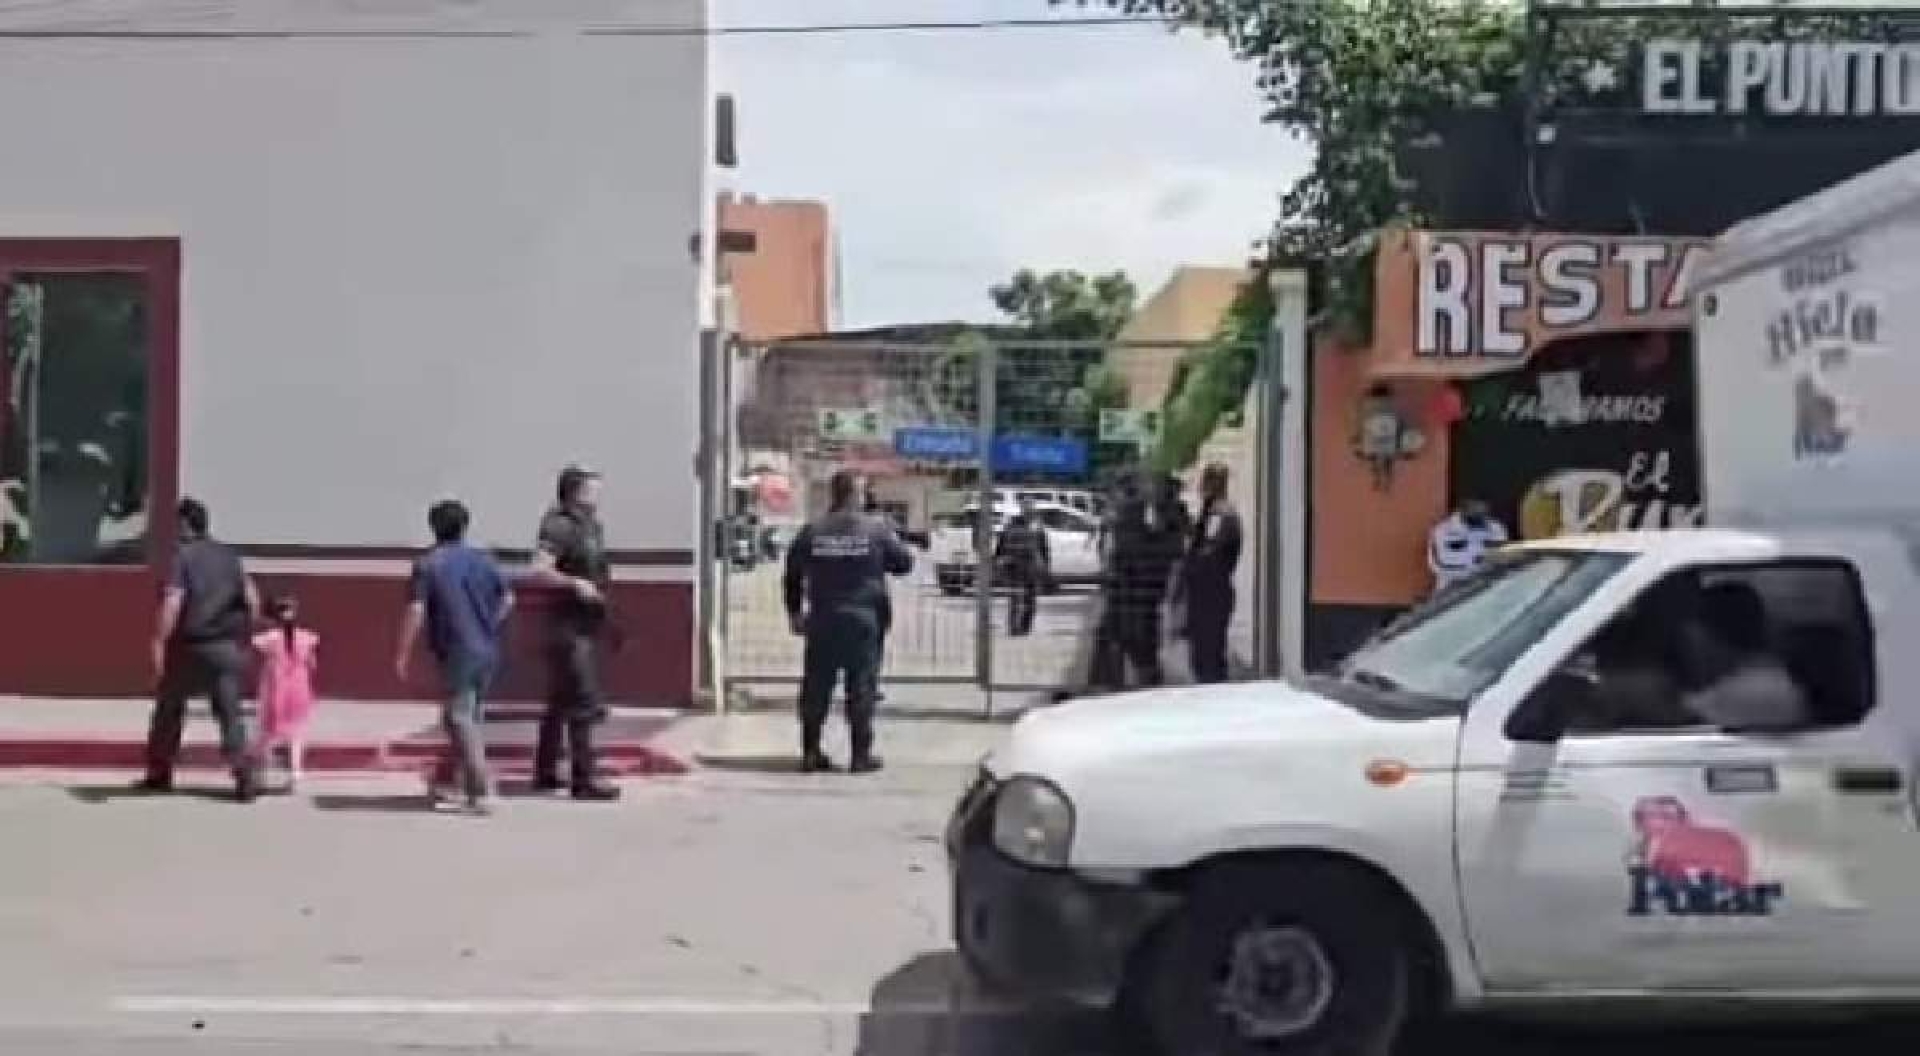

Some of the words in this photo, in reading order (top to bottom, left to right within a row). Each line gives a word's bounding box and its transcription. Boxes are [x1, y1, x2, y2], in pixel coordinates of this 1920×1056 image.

[1643, 39, 1716, 115] EL
[1727, 40, 1920, 116] PUNTO
[1627, 863, 1783, 917] Polar
